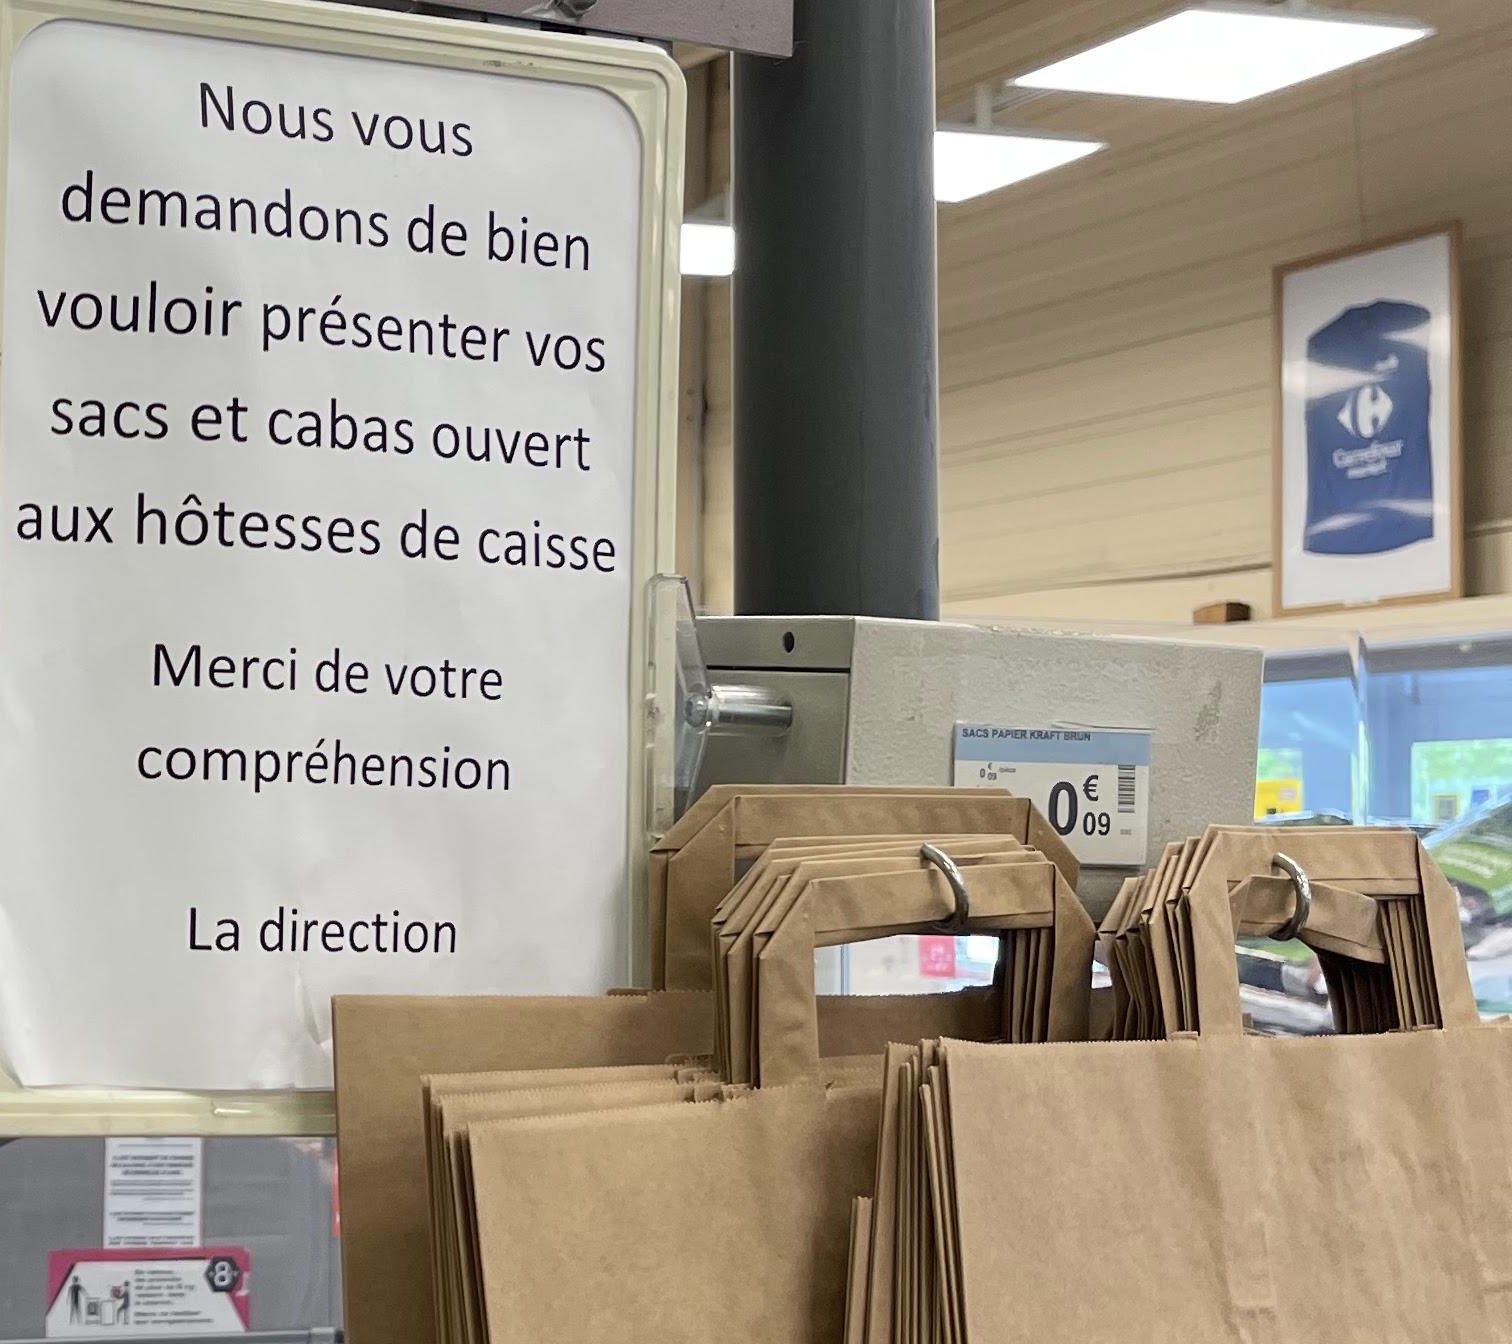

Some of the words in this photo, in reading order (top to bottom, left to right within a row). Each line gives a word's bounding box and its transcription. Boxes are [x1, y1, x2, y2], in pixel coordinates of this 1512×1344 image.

[199, 81, 335, 143] Nous
[350, 110, 474, 158] vous
[60, 168, 390, 249] demandons
[406, 202, 469, 258] de
[487, 209, 590, 272] bien
[36, 279, 244, 338] vouloir
[261, 293, 511, 364] présenter
[524, 330, 606, 374] vos
[50, 397, 170, 441] sacs
[190, 396, 250, 444] et
[267, 396, 415, 456] cabas
[431, 422, 591, 472] ouvert
[16, 502, 115, 545] aux
[135, 491, 382, 557] hôtesses
[399, 507, 461, 562] de
[477, 519, 616, 574] caisse
[152, 642, 298, 692] Merci
[314, 646, 370, 695] de
[383, 658, 504, 702] votre
[962, 728, 989, 739] SACS
[991, 729, 1027, 741] PAPIER
[1029, 730, 1062, 742] KRAFT
[1063, 732, 1091, 742] BRUN
[136, 737, 511, 795] compréhension
[1082, 774, 1099, 802] €
[1048, 781, 1079, 836] 0
[1082, 812, 1111, 836] 09
[188, 906, 241, 953] La
[258, 905, 457, 954] direction
[214, 1261, 232, 1286] 8
